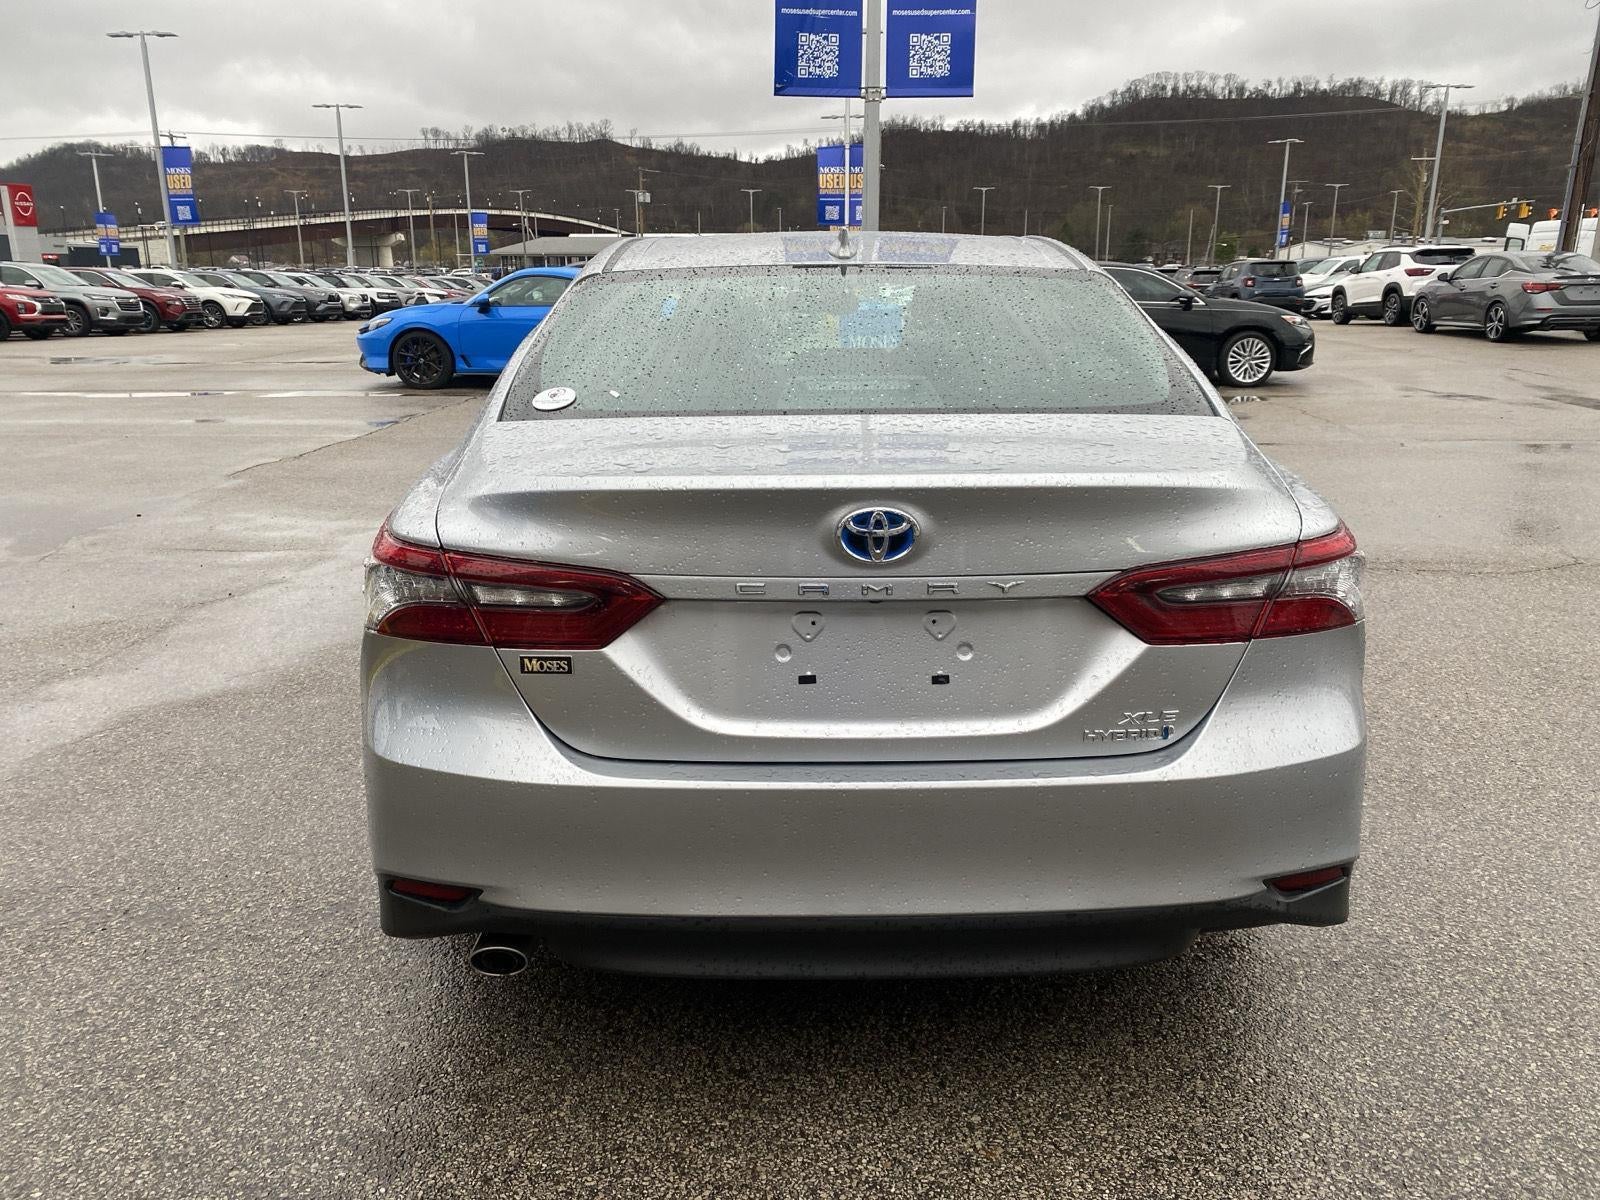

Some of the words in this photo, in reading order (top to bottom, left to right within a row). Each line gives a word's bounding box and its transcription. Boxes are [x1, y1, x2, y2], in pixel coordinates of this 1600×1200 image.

[781, 8, 858, 16] mosesusedsupercenter.com
[167, 174, 192, 189] USED
[819, 173, 845, 189] USED
[849, 173, 863, 189] US
[734, 580, 1026, 596] CAMRY
[523, 658, 569, 673] MOSES
[1117, 709, 1180, 725] XLE
